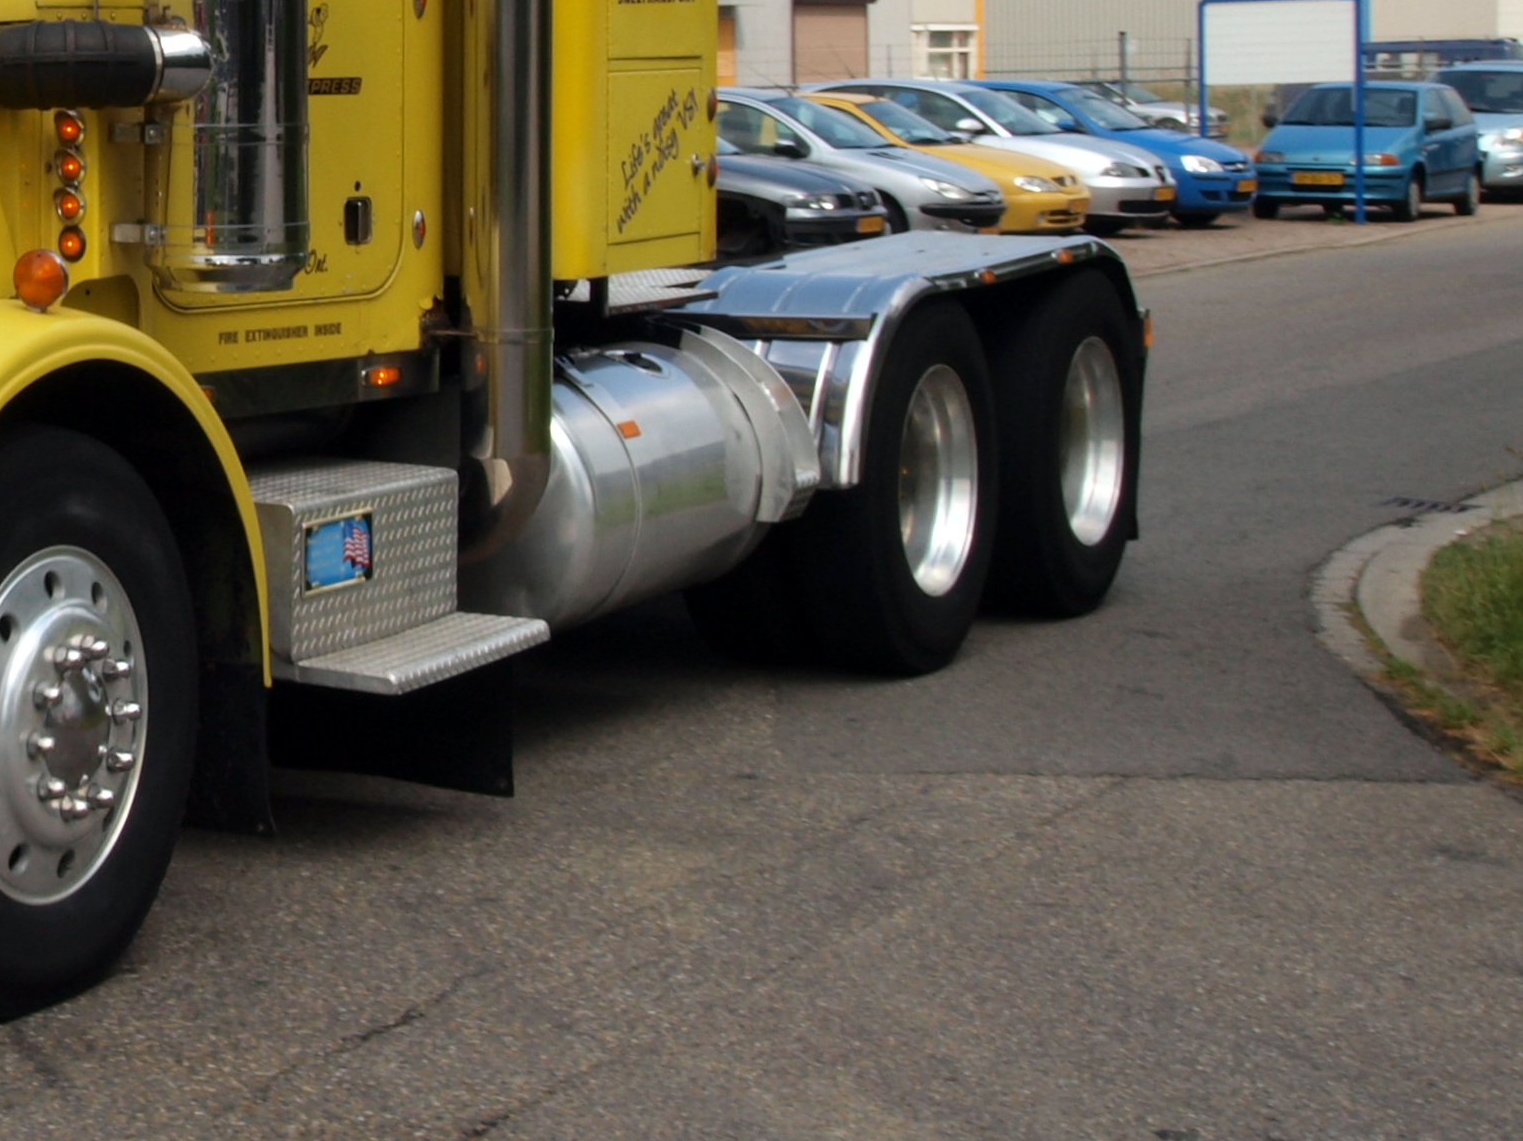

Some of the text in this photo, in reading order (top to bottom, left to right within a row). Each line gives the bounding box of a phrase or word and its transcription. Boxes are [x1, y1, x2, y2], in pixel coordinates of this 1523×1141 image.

[308, 78, 360, 94] PRESS
[219, 323, 341, 345] FIRE EXTINGUISHER INSIDE
